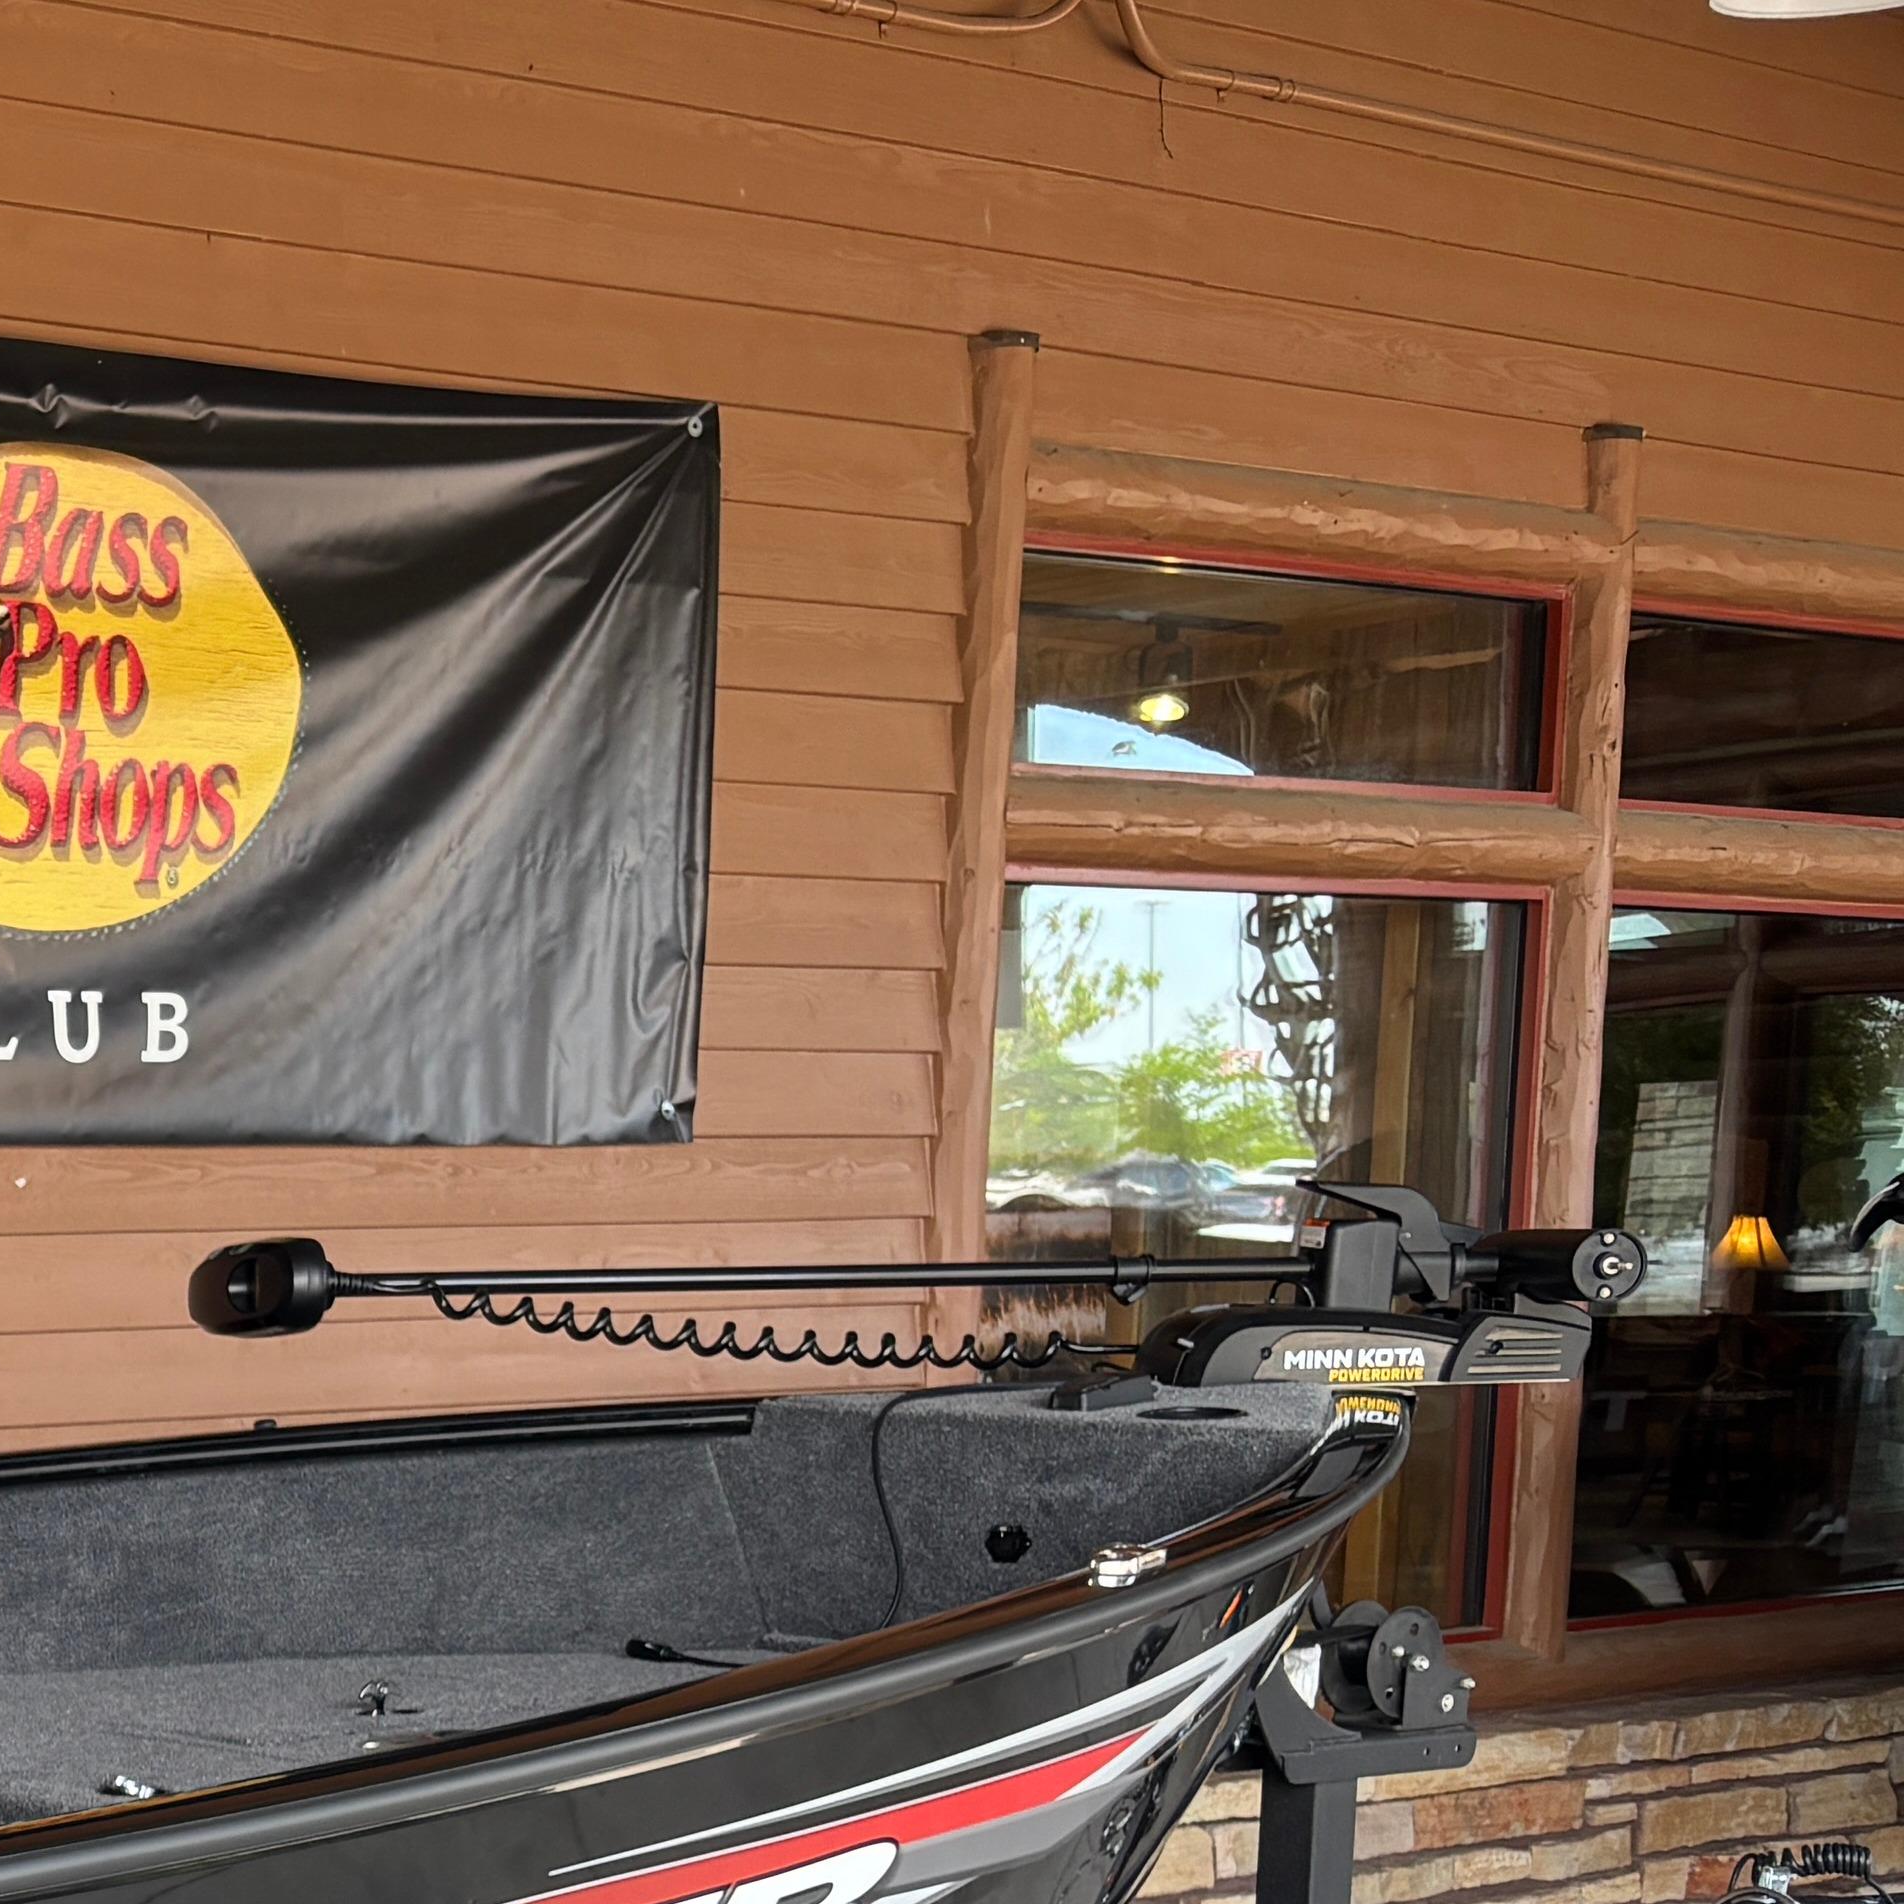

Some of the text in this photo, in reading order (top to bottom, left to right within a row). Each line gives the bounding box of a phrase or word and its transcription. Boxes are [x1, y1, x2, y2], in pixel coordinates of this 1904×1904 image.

[1283, 1347, 1425, 1370] MINN KOTA
[1328, 1367, 1425, 1382] POWERDRIVE
